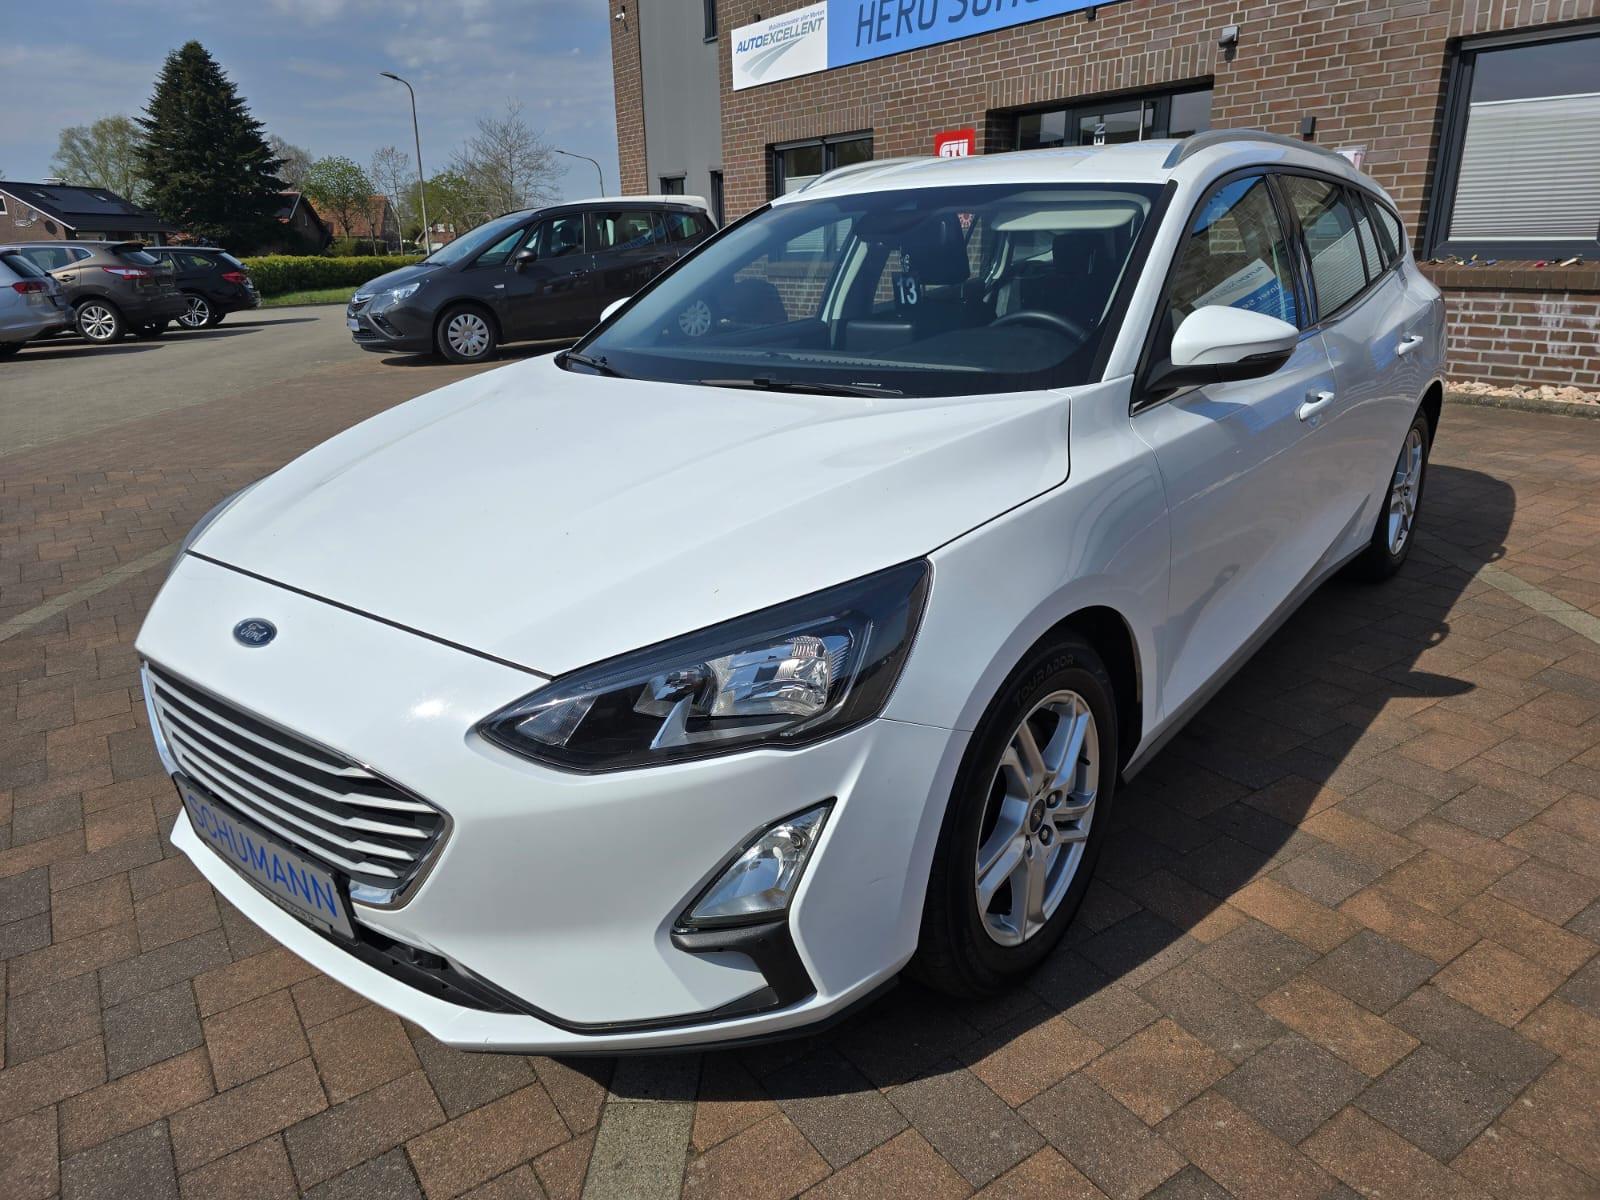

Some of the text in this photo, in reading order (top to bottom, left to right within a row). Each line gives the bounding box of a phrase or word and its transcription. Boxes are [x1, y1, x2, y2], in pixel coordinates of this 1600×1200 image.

[736, 17, 825, 54] AUTOEXCELLENT
[896, 277, 918, 305] 13
[187, 794, 338, 918] SCHUMANN
